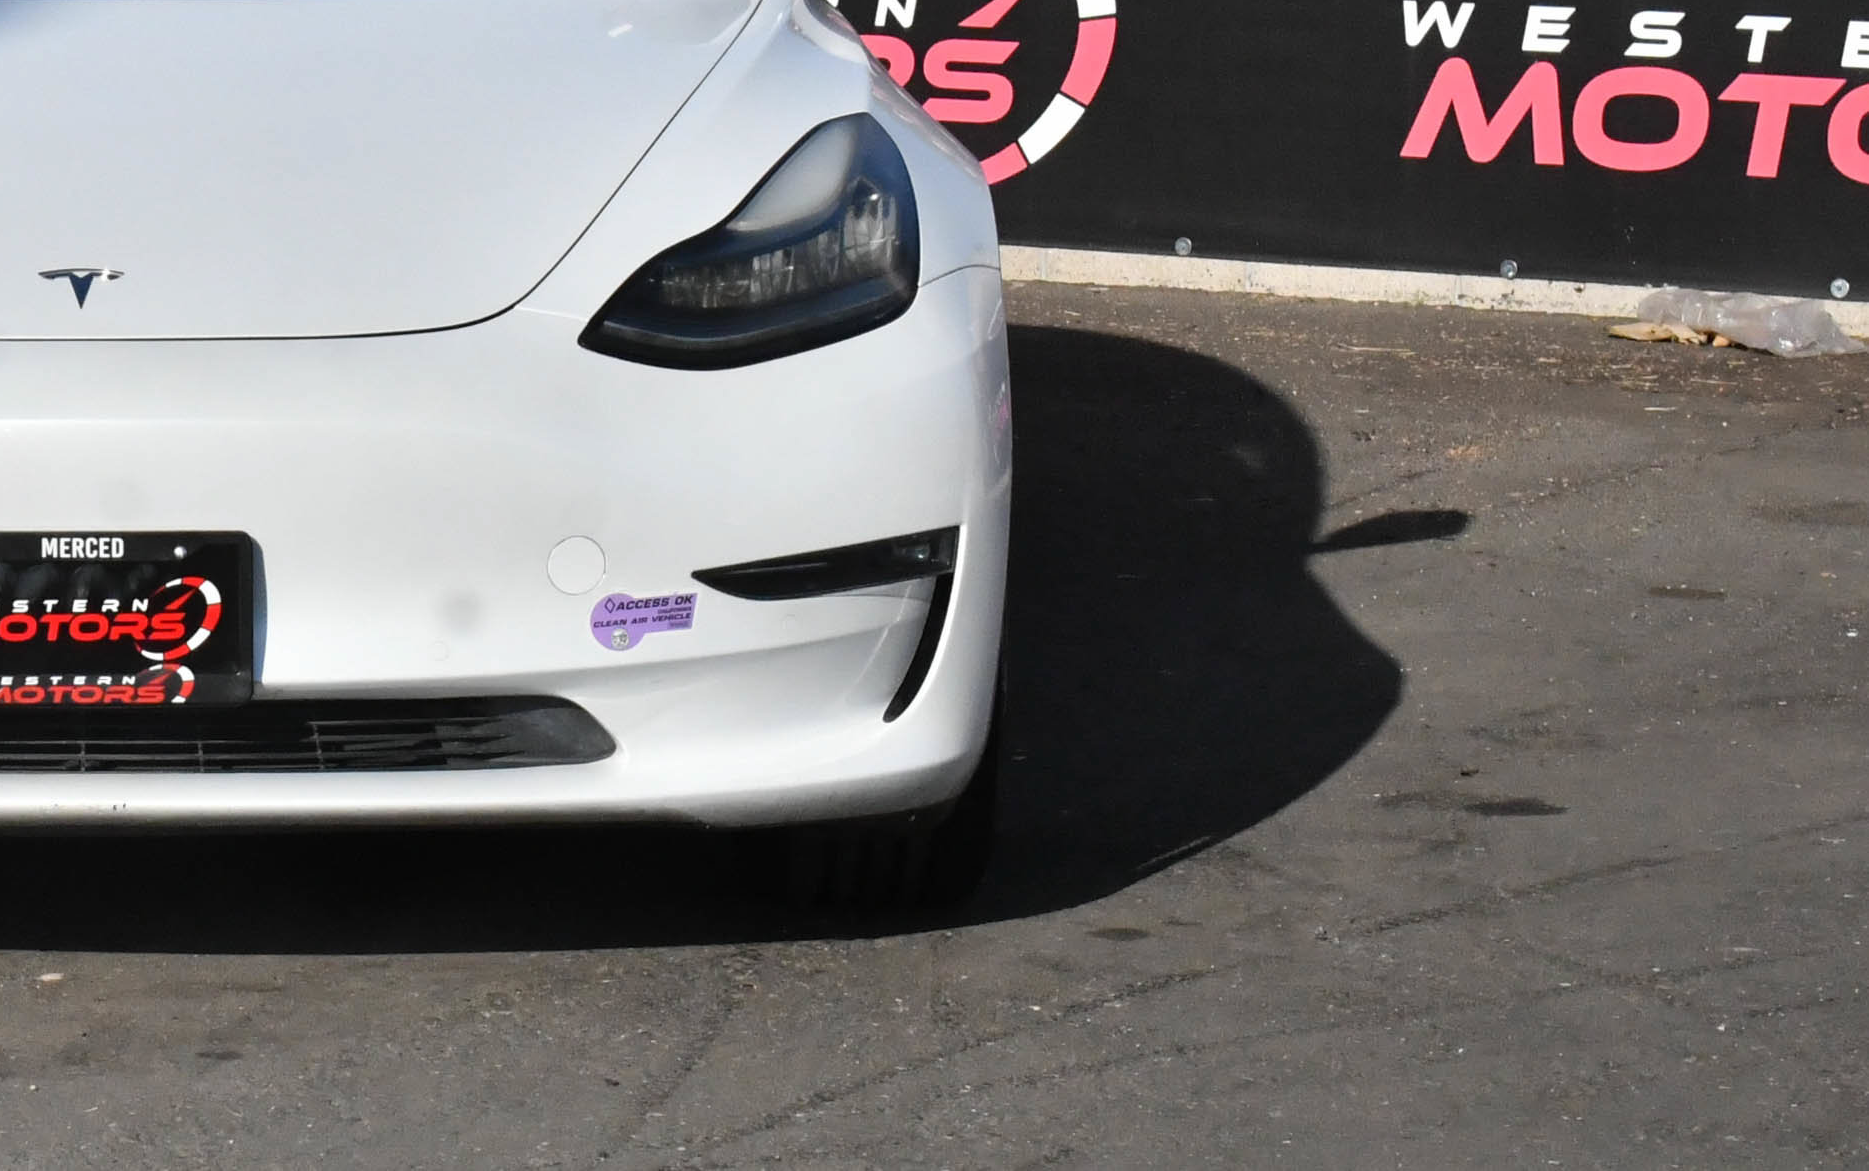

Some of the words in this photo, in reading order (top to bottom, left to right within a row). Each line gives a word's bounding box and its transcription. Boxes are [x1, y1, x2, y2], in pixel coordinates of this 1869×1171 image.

[41, 537, 125, 559] MERCED
[616, 597, 670, 612] ACCESS
[675, 595, 693, 605] OK
[593, 618, 627, 628] CLEAN
[631, 617, 648, 625] AIR
[652, 613, 692, 622] VEHICLE
